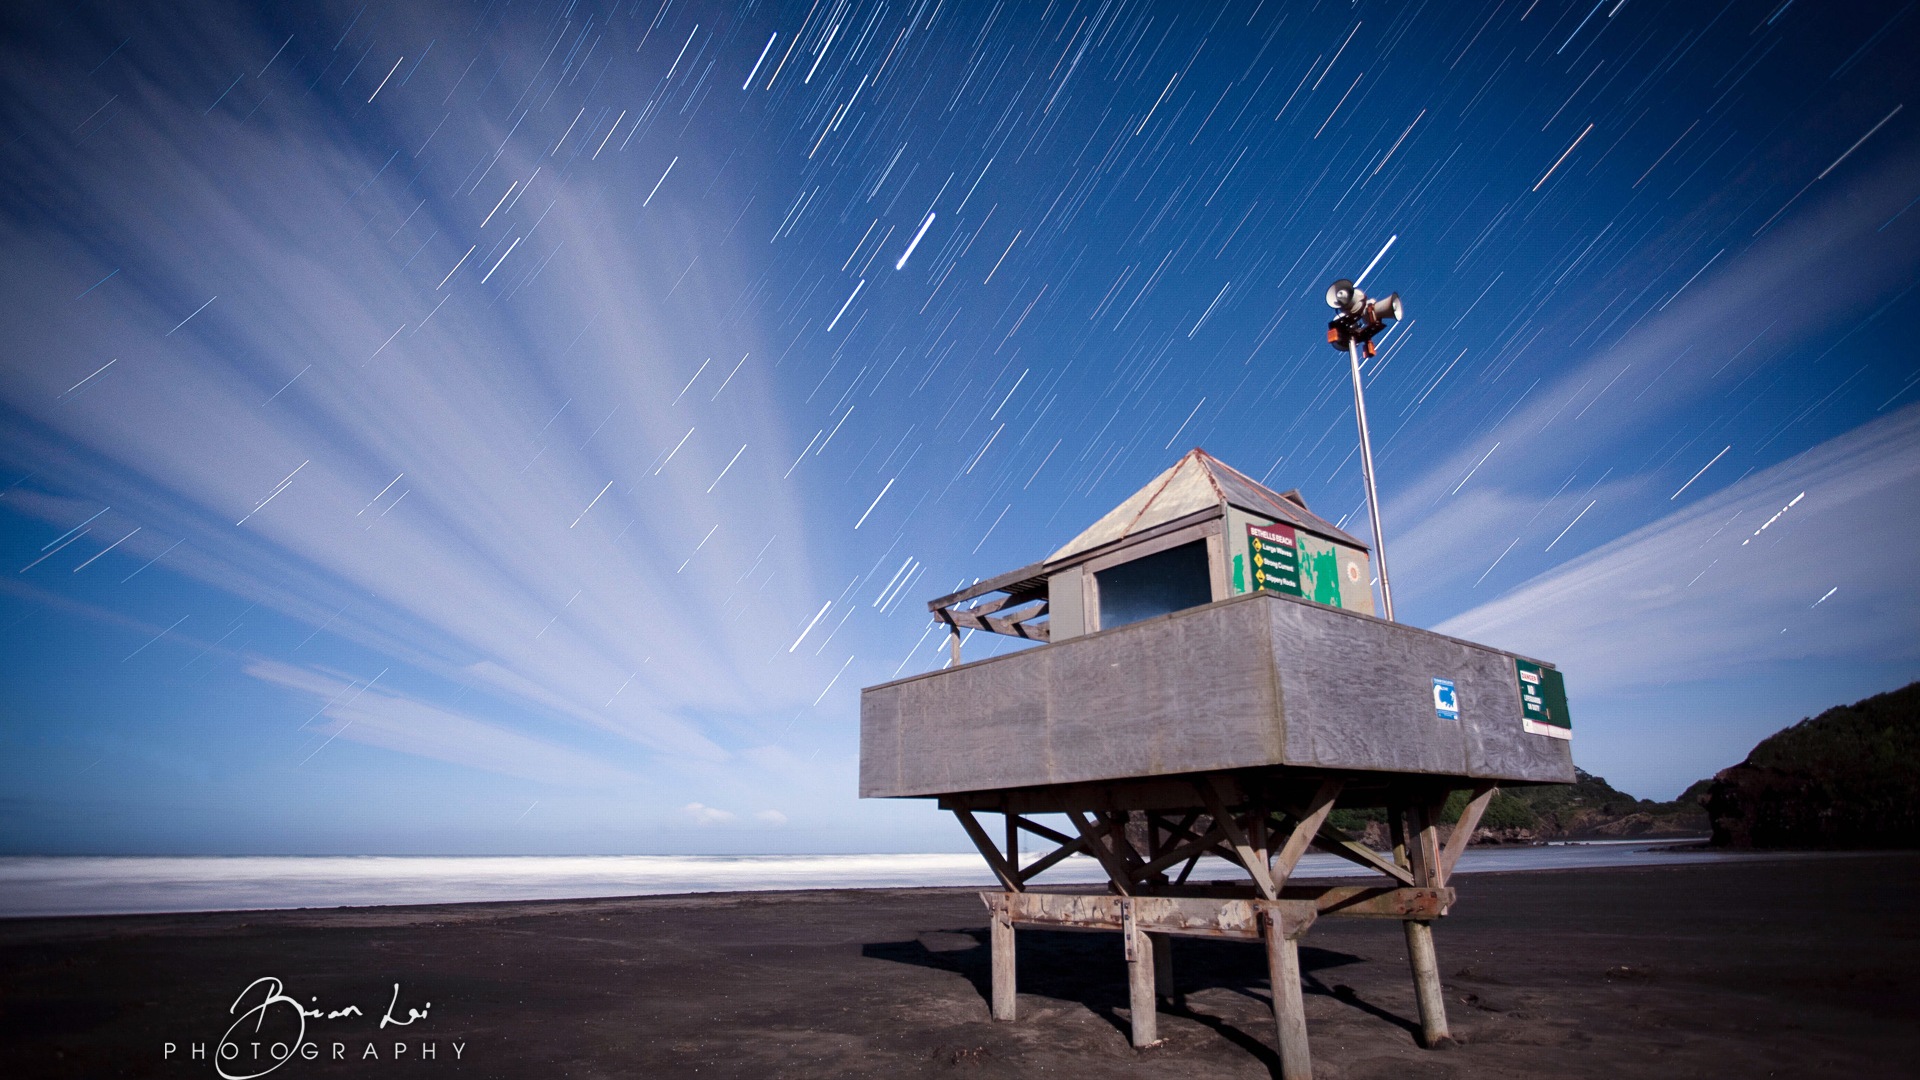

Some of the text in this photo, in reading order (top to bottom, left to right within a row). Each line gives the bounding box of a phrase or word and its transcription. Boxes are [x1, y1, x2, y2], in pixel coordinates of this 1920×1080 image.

[1250, 528, 1293, 546] BETHELLS BEACH
[1262, 543, 1292, 557] Large Waves
[1263, 558, 1294, 572] Strong Current
[1266, 574, 1282, 585] Slippery
[1522, 672, 1536, 681] DANGER
